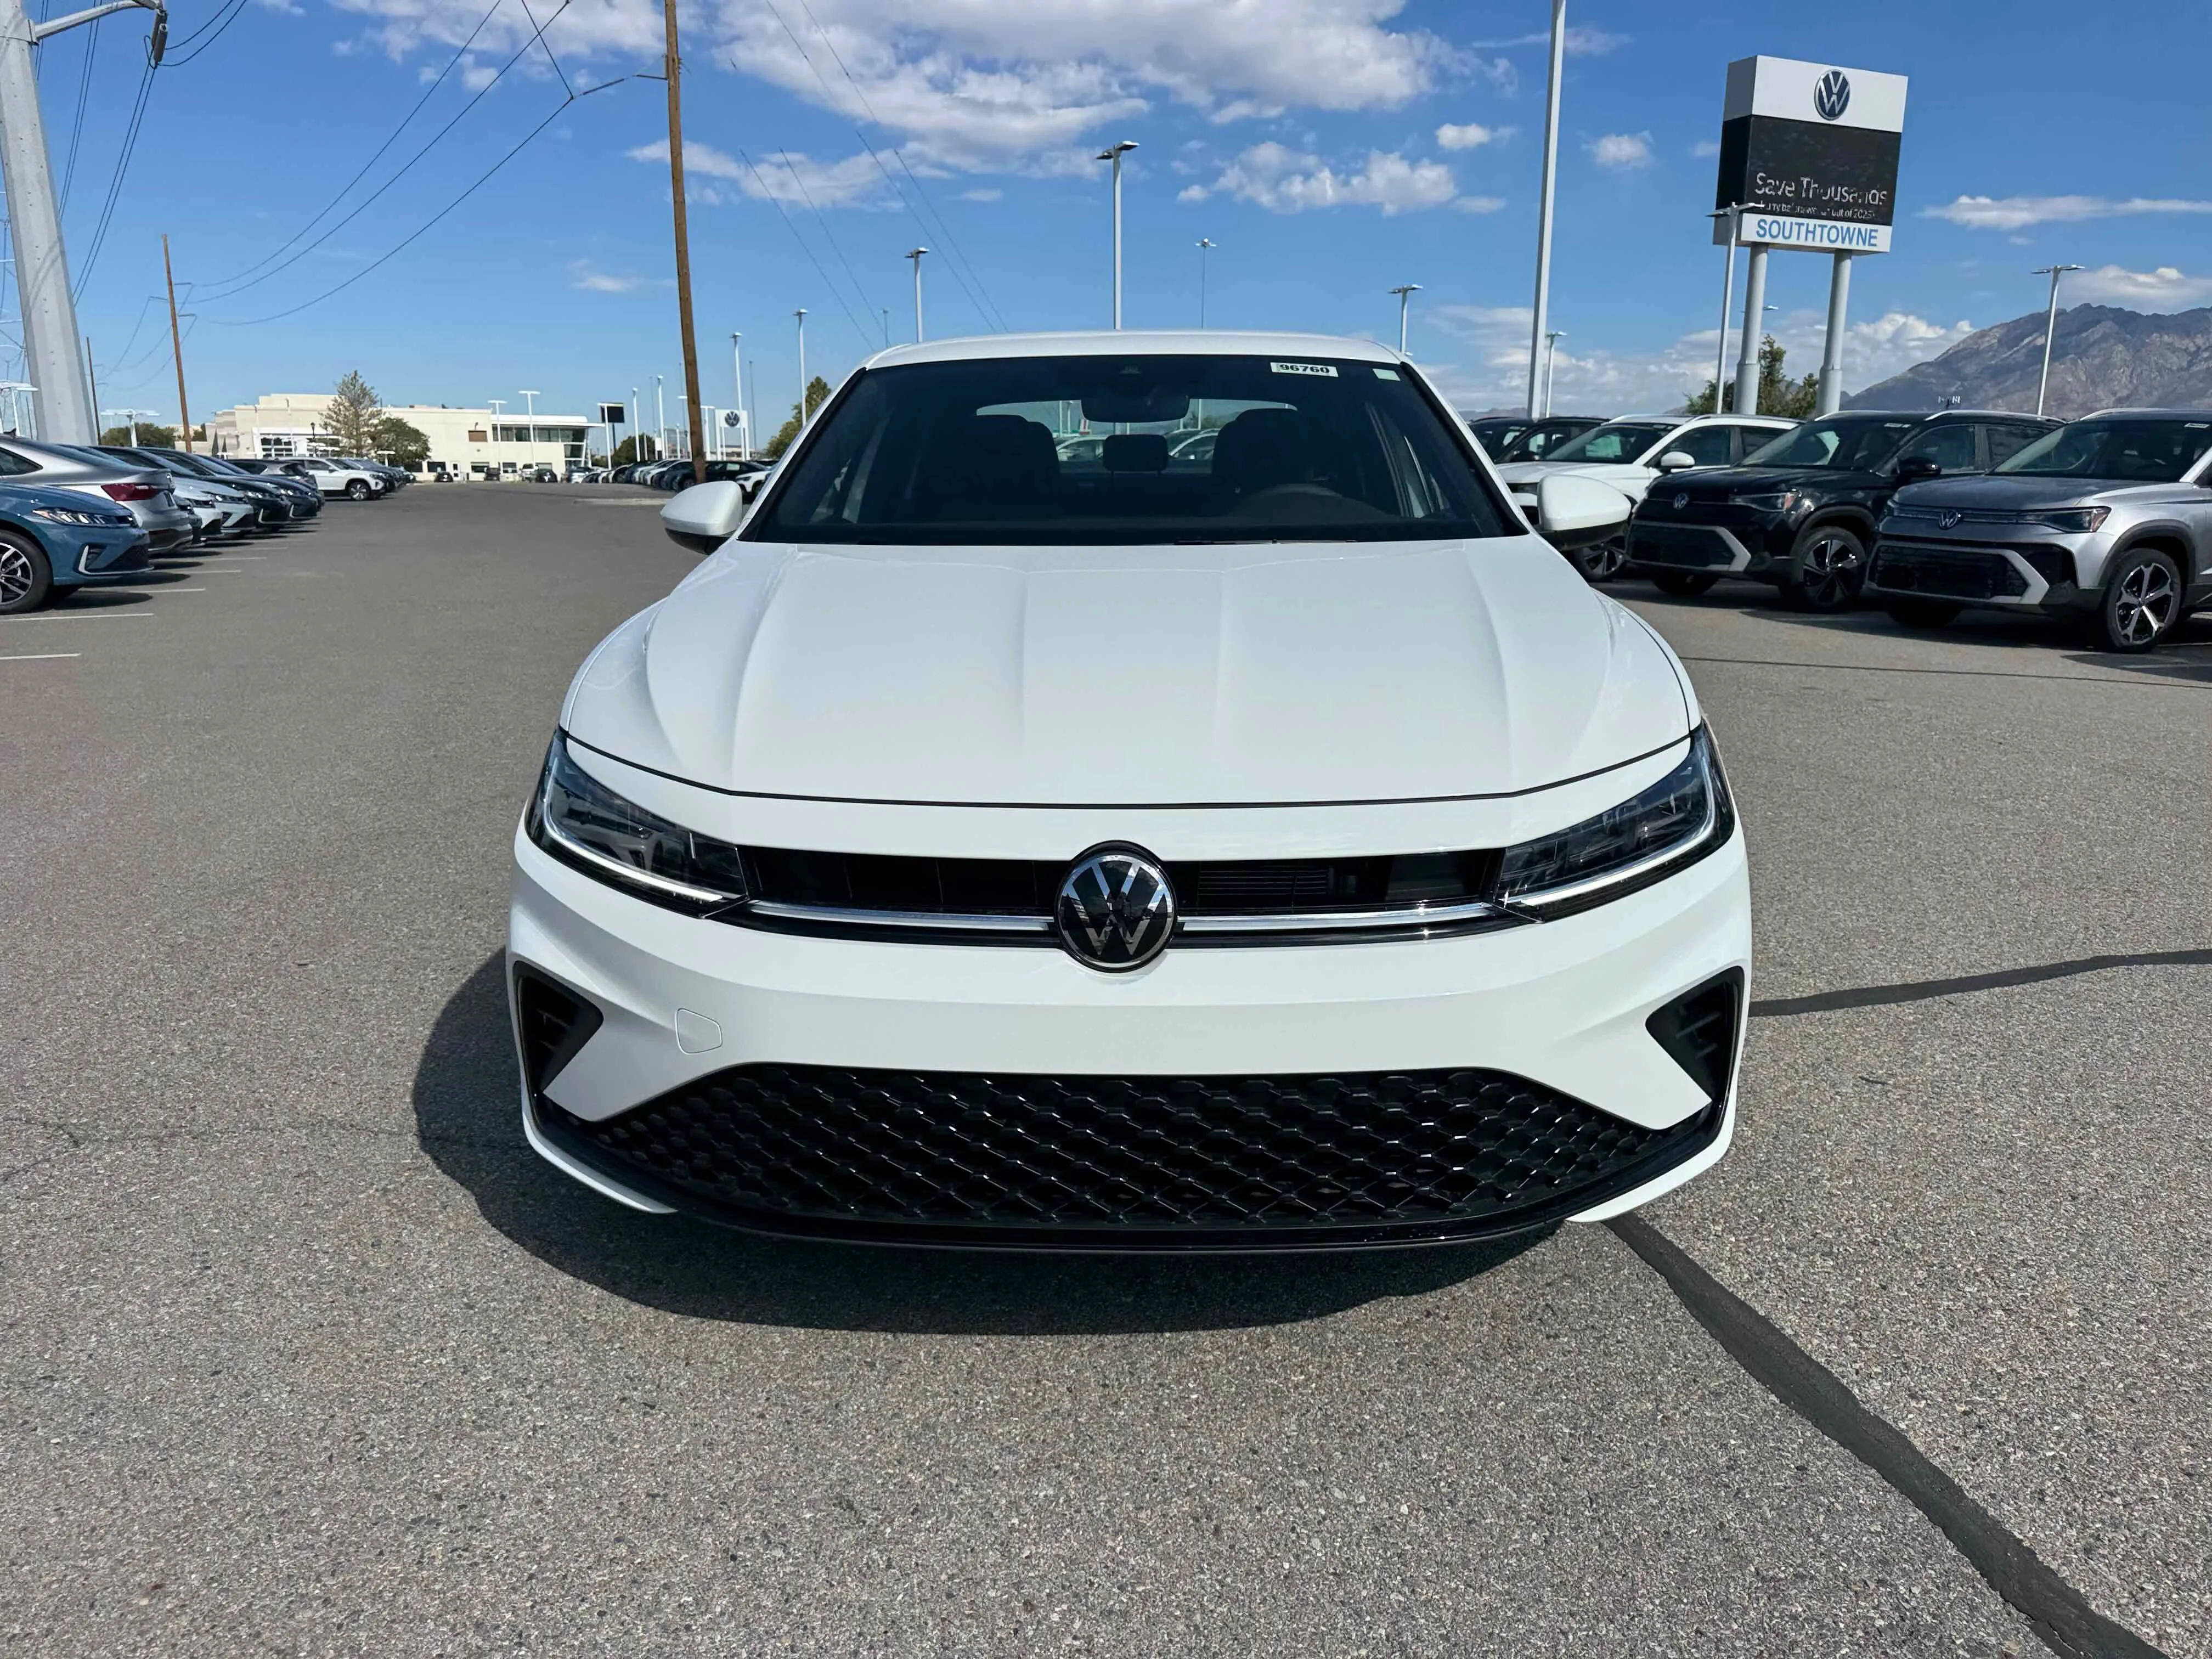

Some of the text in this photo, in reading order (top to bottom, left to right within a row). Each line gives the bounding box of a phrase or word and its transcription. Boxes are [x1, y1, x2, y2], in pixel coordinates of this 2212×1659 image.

[1816, 70, 1850, 117] VW
[1756, 172, 1795, 197] Save
[1756, 219, 1878, 247] SOUTHTOWNE
[1279, 364, 1330, 374] 96760
[1060, 856, 1172, 960] VW
